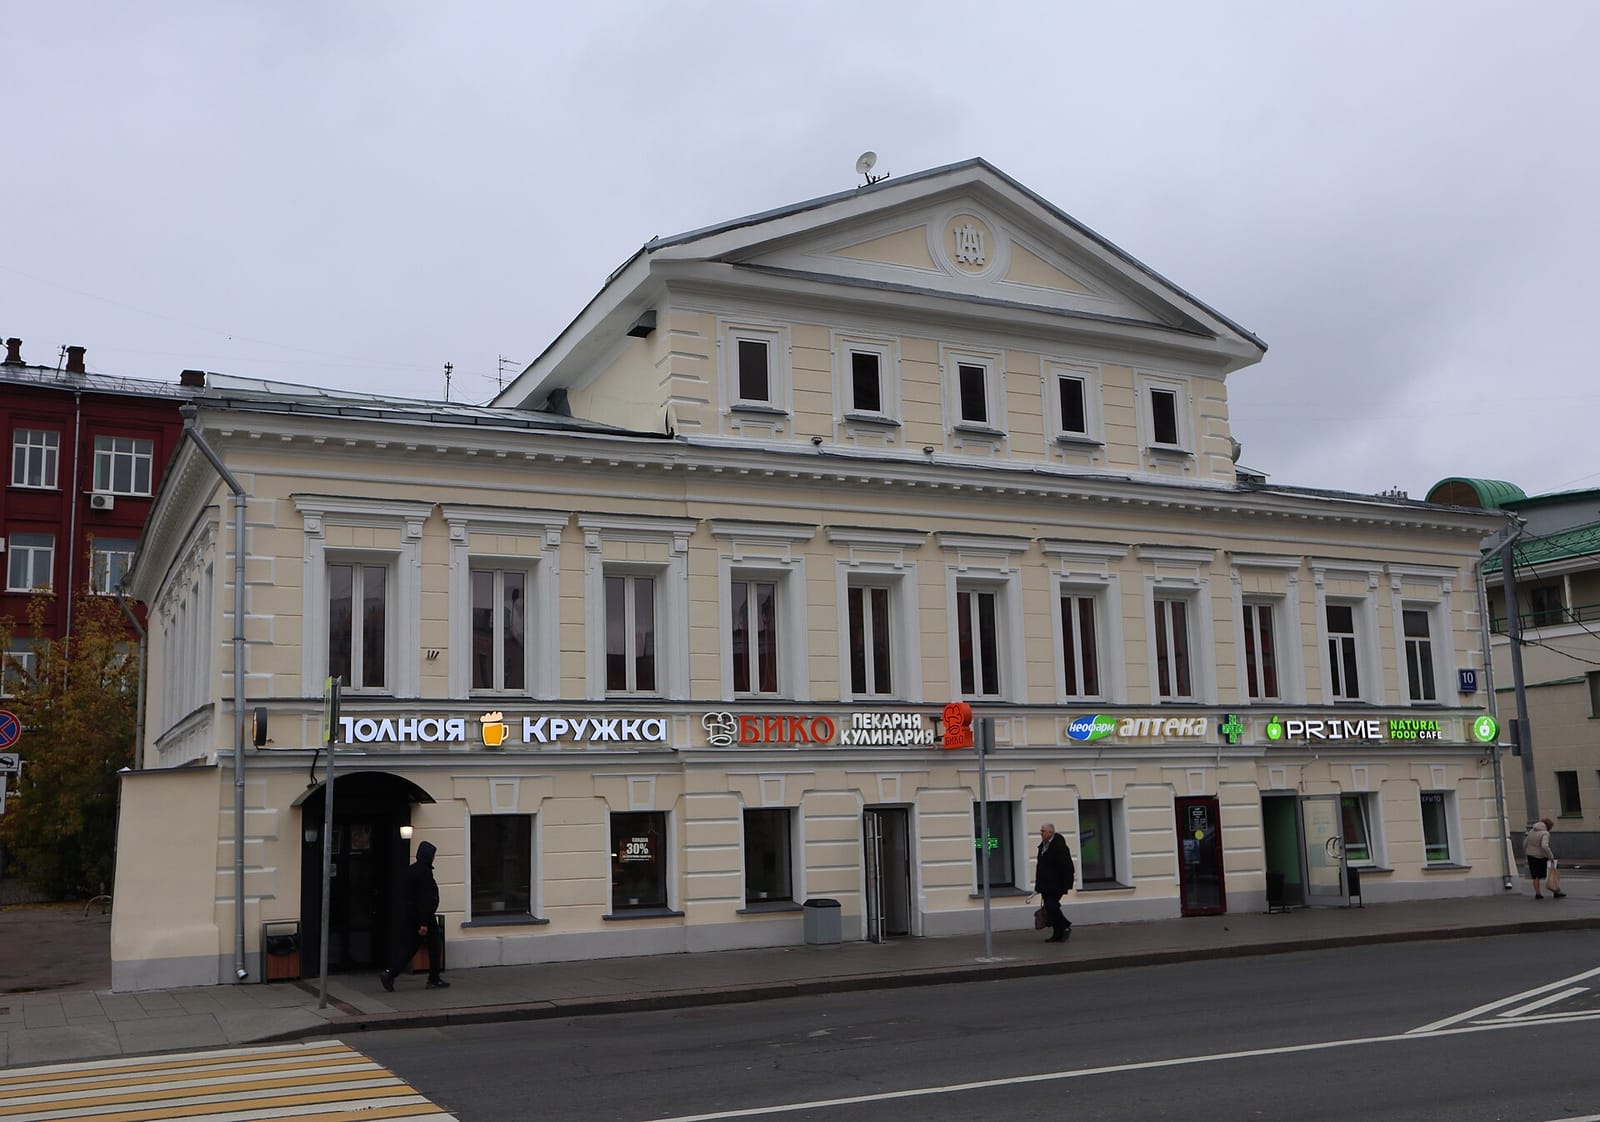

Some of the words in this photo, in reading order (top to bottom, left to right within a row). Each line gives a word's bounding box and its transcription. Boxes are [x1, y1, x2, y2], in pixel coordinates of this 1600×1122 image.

[1462, 672, 1474, 684] 10
[852, 713, 922, 730] ПЕКАРНЯ
[1069, 720, 1115, 735] неофарм
[1119, 717, 1208, 737] аптека
[1389, 719, 1442, 731] NATURAL
[737, 715, 836, 744] БИКО
[1286, 720, 1384, 740] PRIME
[1391, 730, 1417, 740] FOOD
[1419, 730, 1443, 740] CAFE
[840, 729, 935, 746] КУЛИНАРИЯ
[945, 735, 964, 746] БИКО
[626, 842, 649, 855] 30%
